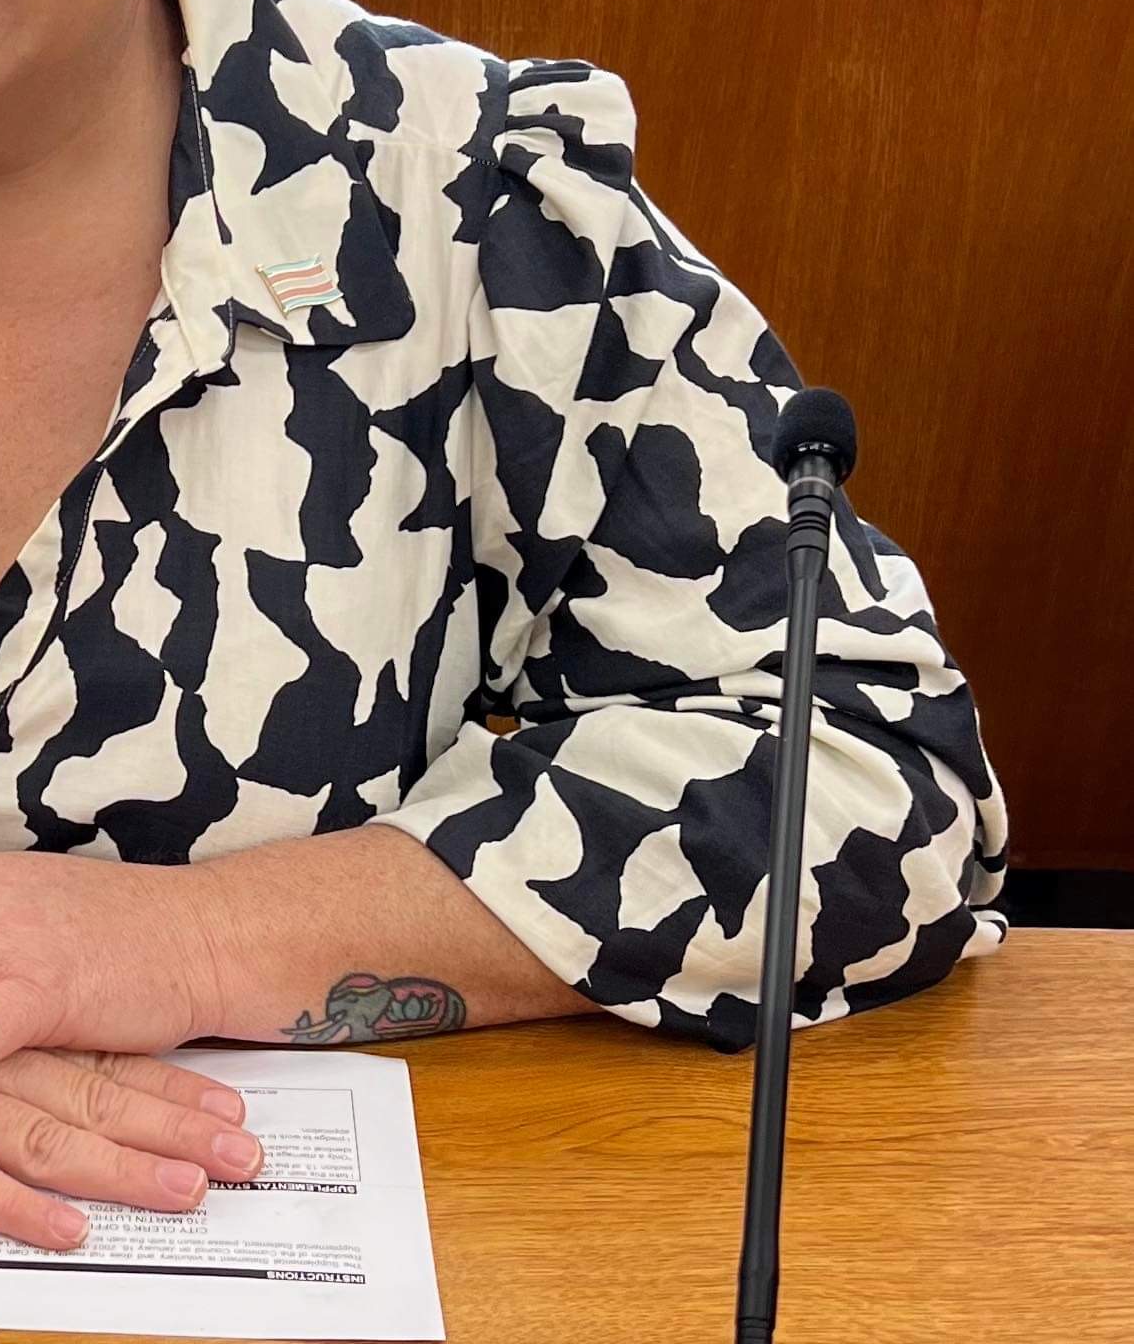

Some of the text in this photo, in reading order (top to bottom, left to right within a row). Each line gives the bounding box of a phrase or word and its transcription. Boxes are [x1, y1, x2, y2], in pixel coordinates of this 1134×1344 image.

[254, 1183, 355, 1193] SUPPLEMENTAL
[135, 1216, 183, 1224] MARTIN
[123, 1224, 175, 1232] CLERK'S
[267, 1271, 363, 1283] INSTRUCTIONS
